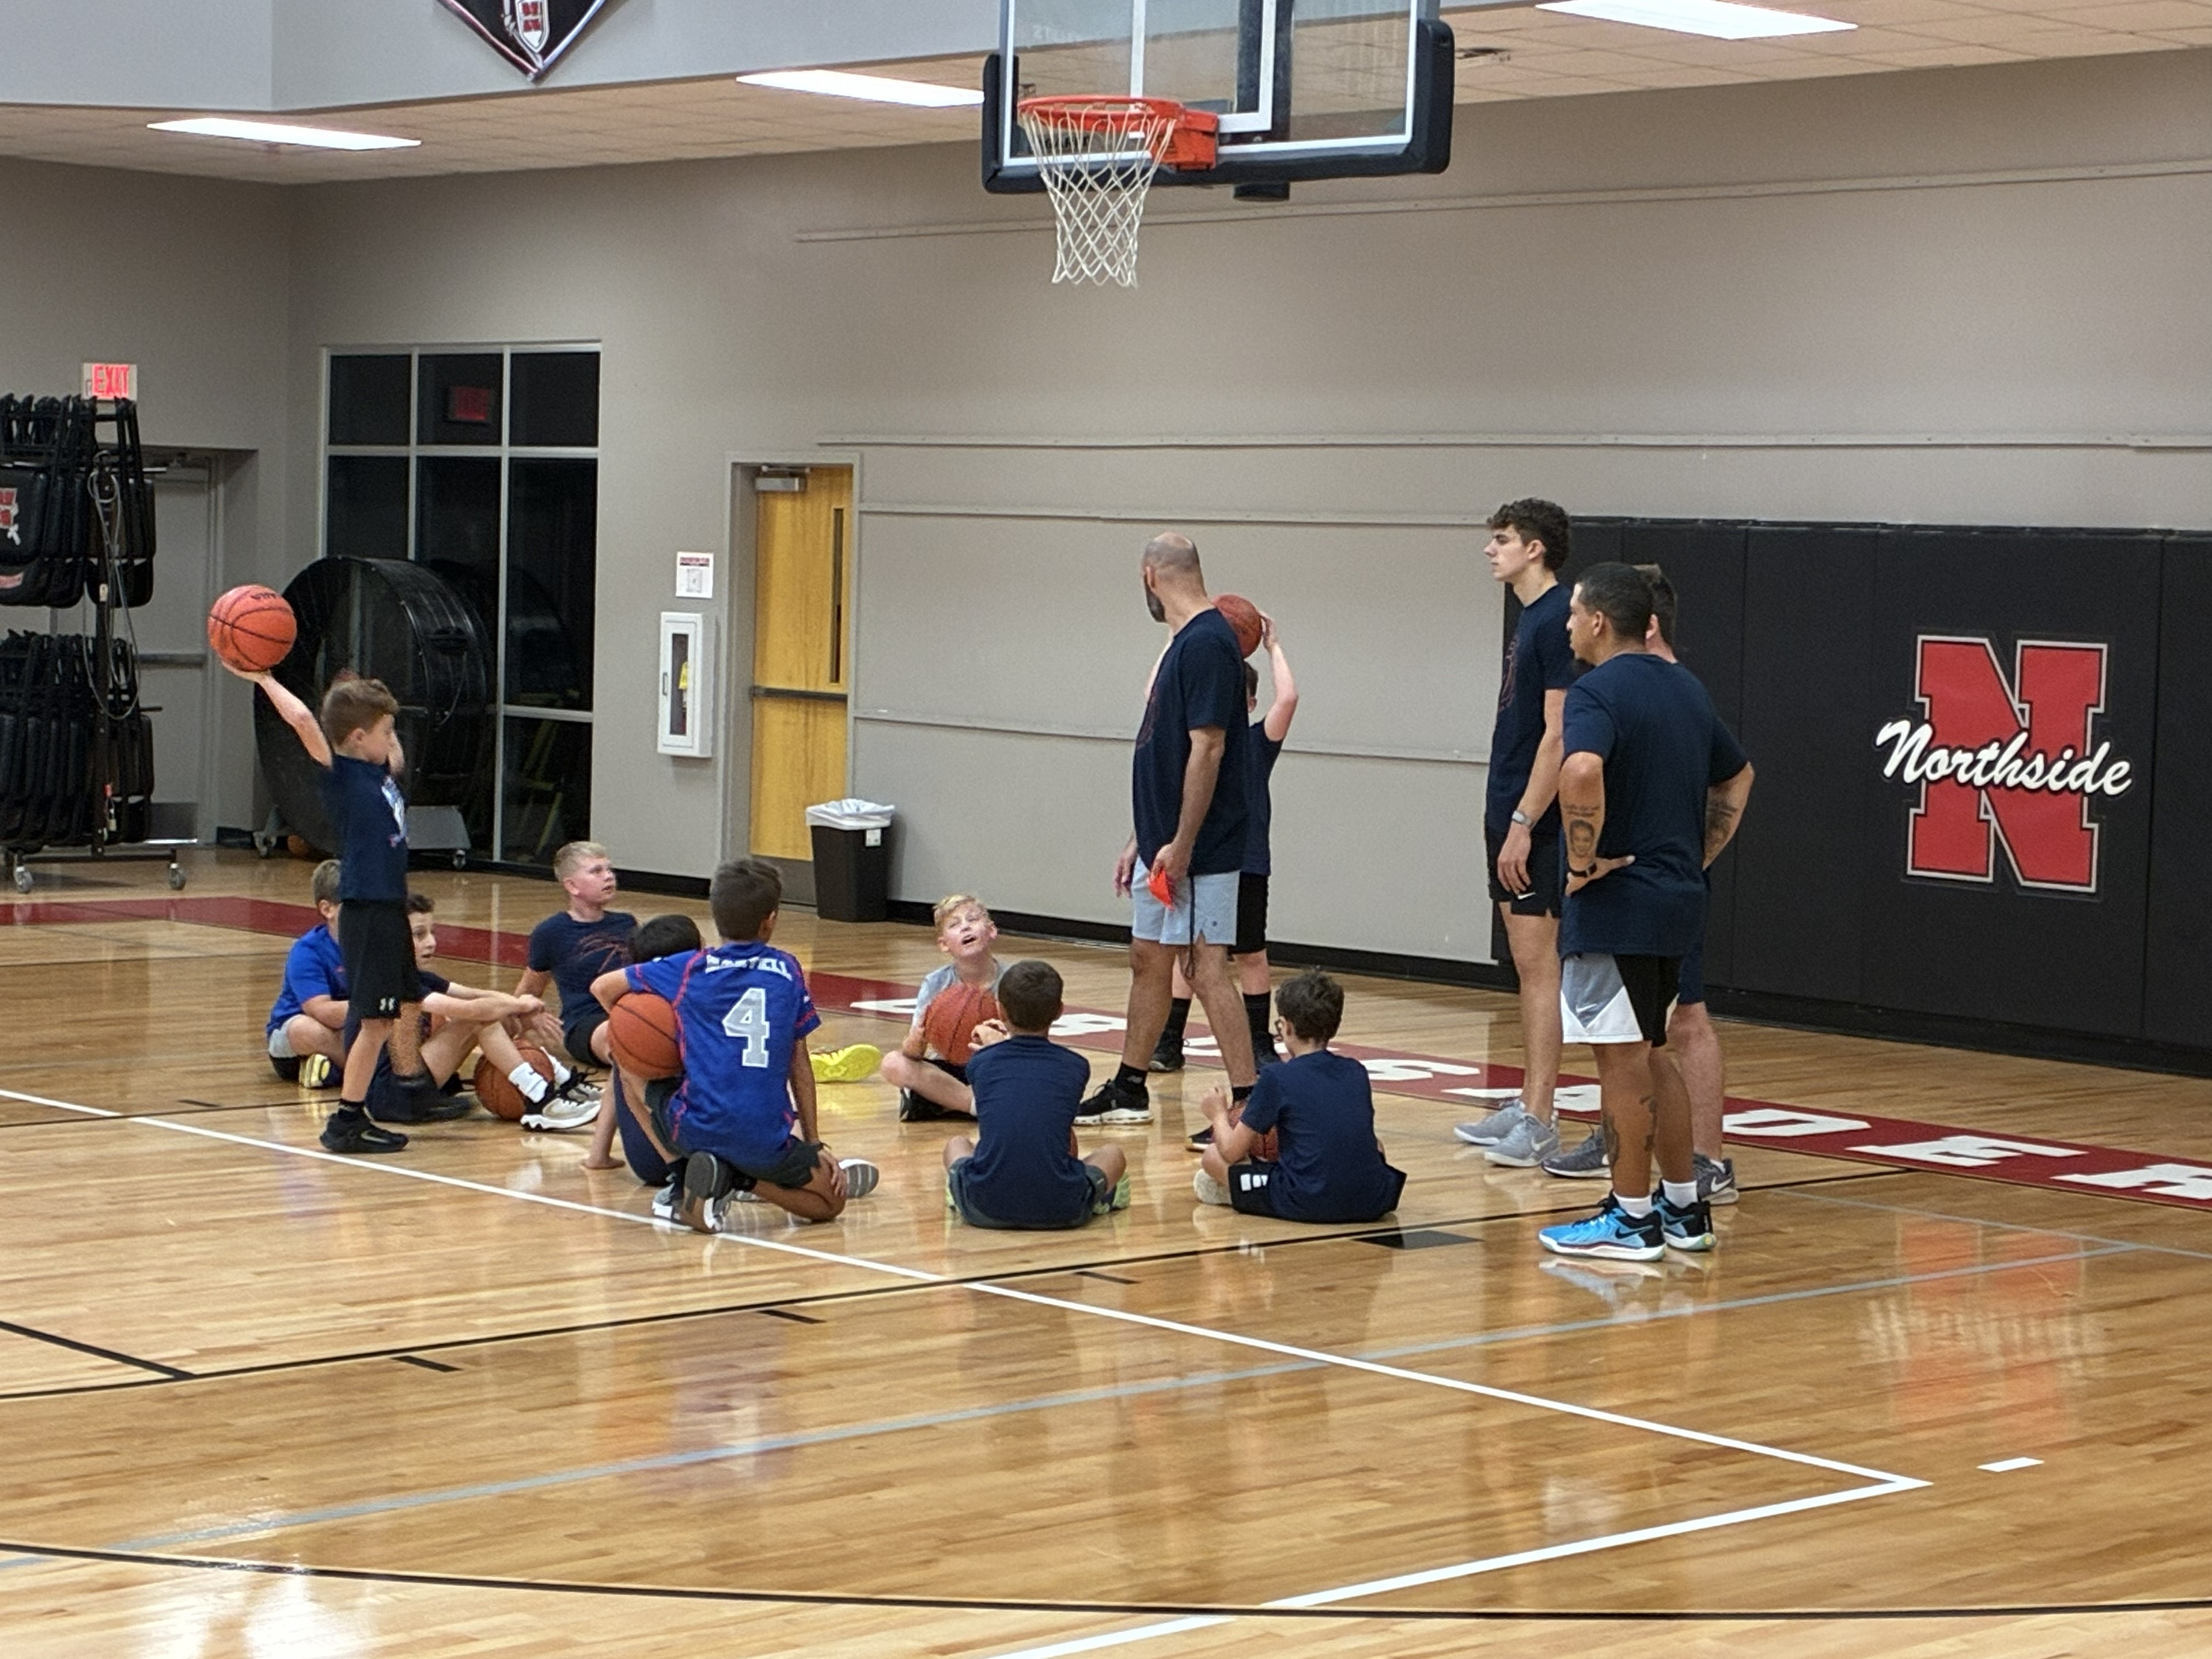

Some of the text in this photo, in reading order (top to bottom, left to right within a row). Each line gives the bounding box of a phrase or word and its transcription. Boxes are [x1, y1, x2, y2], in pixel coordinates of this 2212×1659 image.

[93, 365, 130, 396] EXIT
[1876, 719, 2131, 796] Northside
[722, 987, 770, 1068] 4
